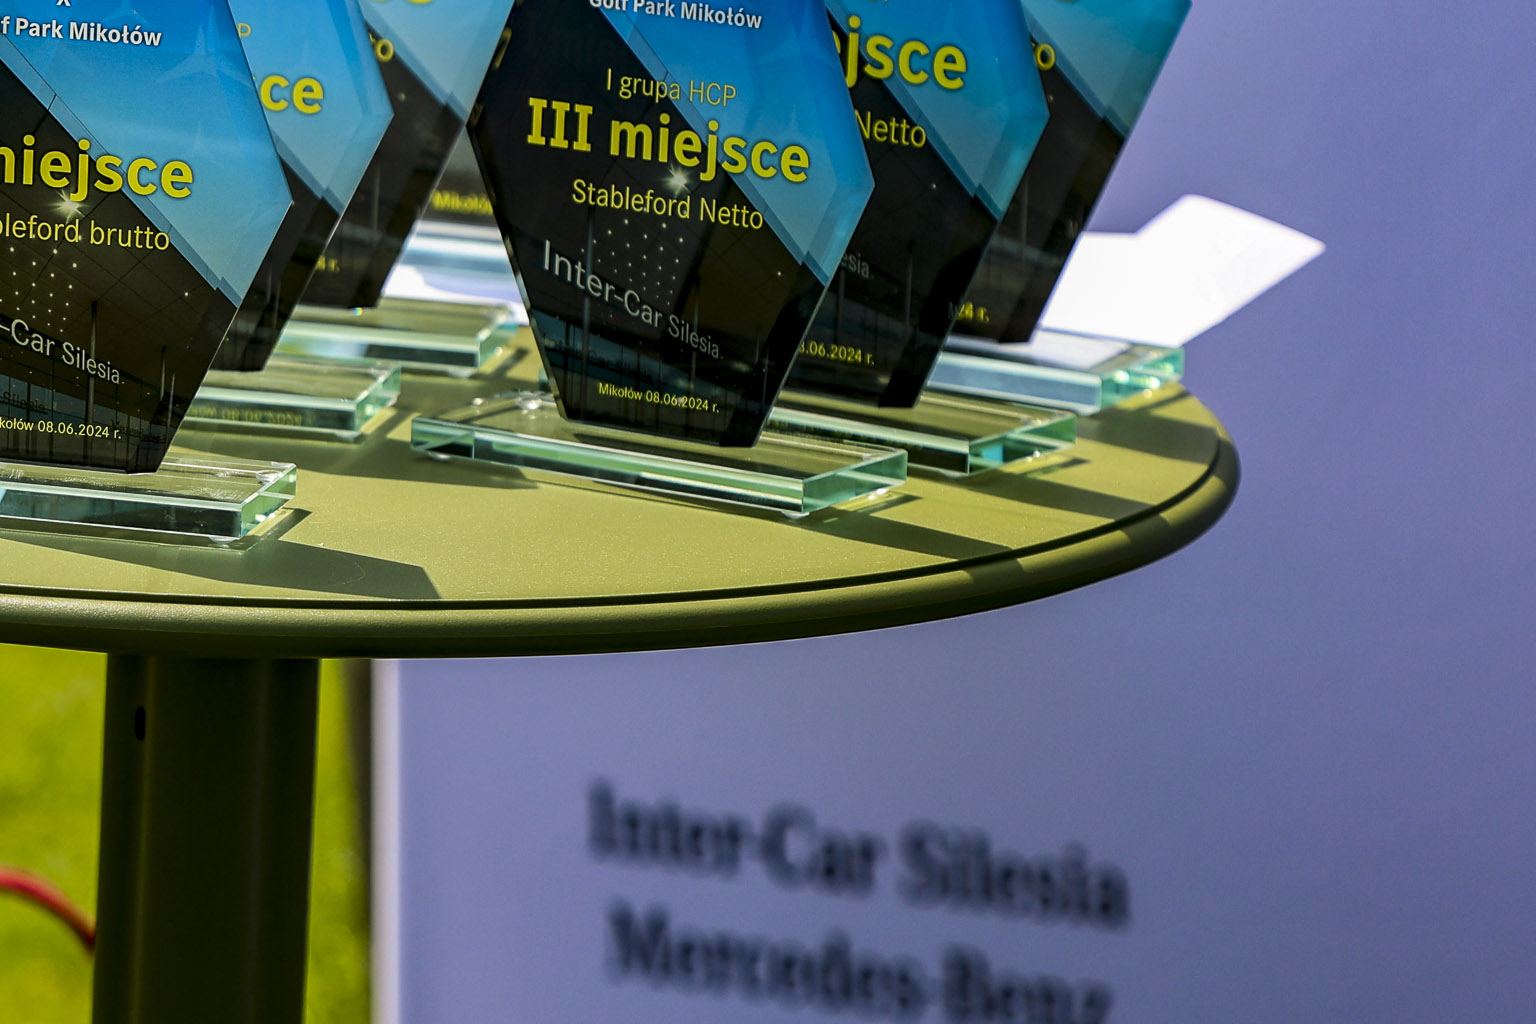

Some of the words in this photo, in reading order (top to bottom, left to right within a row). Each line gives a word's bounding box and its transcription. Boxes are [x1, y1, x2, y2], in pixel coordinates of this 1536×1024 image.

[15, 17, 64, 39] Park
[69, 22, 162, 46] Mikołów
[680, 1, 763, 29] Mikołów
[832, 14, 967, 91] jsce
[619, 74, 681, 104] grupa
[689, 79, 737, 107] HCP
[527, 96, 593, 152] III
[610, 112, 810, 183] miejsce
[855, 109, 926, 148] Netto
[572, 178, 691, 219] Stableford
[699, 196, 764, 230] Netto
[90, 220, 170, 251] brutto
[544, 239, 663, 328] Inter-Car
[598, 382, 643, 401] Mikołów
[645, 390, 709, 411] 08.06.2024
[37, 420, 110, 438] 08.06.2024
[896, 819, 1129, 931] Silesia
